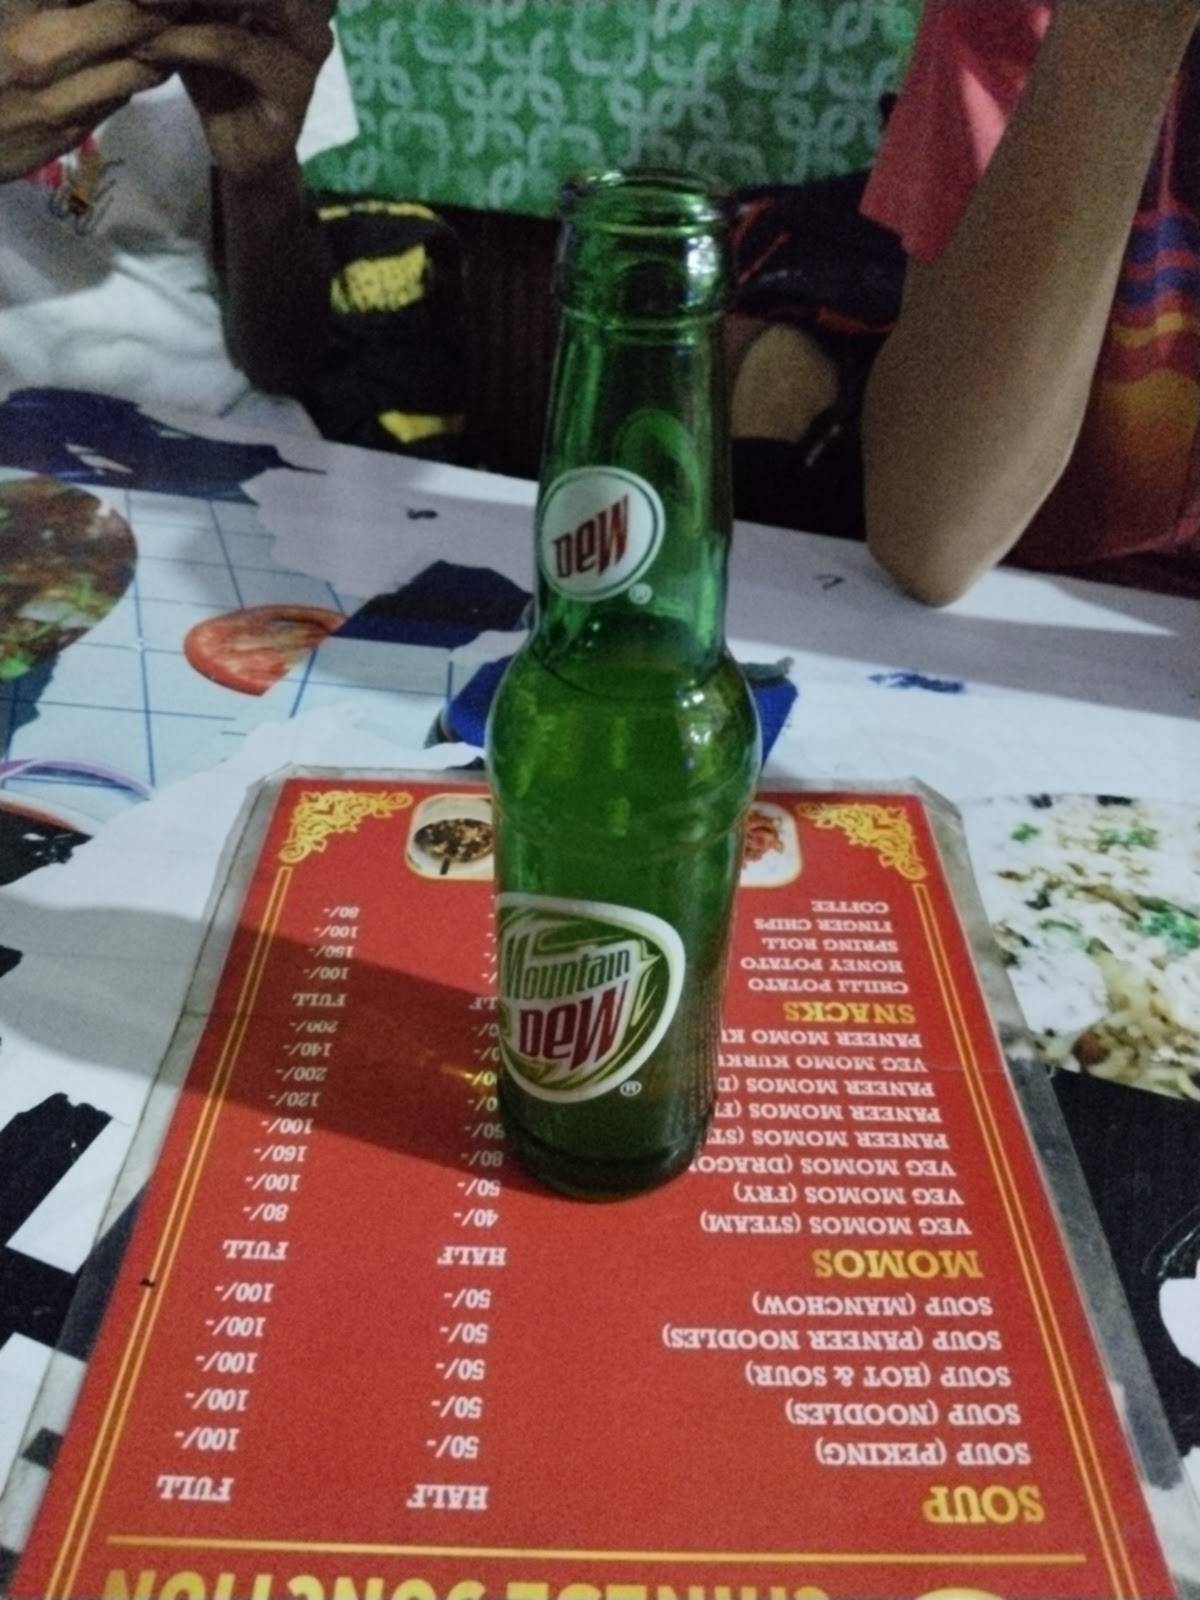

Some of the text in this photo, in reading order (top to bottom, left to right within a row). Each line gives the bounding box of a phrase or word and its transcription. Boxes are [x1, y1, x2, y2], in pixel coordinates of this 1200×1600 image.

[811, 901, 888, 913] COFFEE
[314, 925, 359, 938] 100/-
[754, 918, 892, 932] FINGER CHIPS
[762, 938, 898, 952] SPRING ROLL
[303, 966, 349, 979] 100/-
[503, 934, 630, 1001] Mountain
[741, 957, 902, 972] HONEY POTATO
[748, 978, 909, 993] CHILLI POTATO
[292, 993, 346, 1006] FULL
[783, 1002, 916, 1024] SNACKS
[752, 1030, 828, 1046] MOMO
[835, 1032, 922, 1047] PANEER
[283, 1042, 332, 1057] 140/-
[796, 1055, 875, 1071] MOMO
[882, 1058, 928, 1072] VEG
[276, 1067, 328, 1081] 200/-
[465, 1070, 497, 1084] 0/-
[718, 1075, 934, 1096] PANEER MOMOS (D
[267, 1092, 320, 1107] 120/-
[467, 1096, 497, 1110] 0/-
[714, 1100, 942, 1122] PANEER MOMOS (F
[261, 1118, 313, 1134] 100/-
[707, 1126, 948, 1148] PANEER MOMOS (ST
[687, 1154, 955, 1176] VEG MOMOS (DRAGO
[245, 1173, 301, 1190] 100/-
[457, 1179, 500, 1196] 50/-
[733, 1182, 963, 1205] VEG MOMOS (FRY)
[242, 1203, 289, 1221] 80/-
[453, 1209, 498, 1226] 40/-
[701, 1211, 971, 1234] VEG MOMOS (STEAM)
[223, 1240, 289, 1260] FULL
[437, 1246, 506, 1266] HALF
[812, 1250, 982, 1278] MOMOS
[215, 1282, 274, 1302] 100/-
[444, 1288, 491, 1308] 50/-
[753, 1291, 992, 1315] SOUP (MANCHOW)
[206, 1316, 266, 1336] 100/-
[440, 1322, 488, 1343] 50/-
[662, 1324, 1001, 1349] SOUP (PANEER NOODLES)
[196, 1351, 257, 1373] 100/-
[436, 1358, 485, 1380] 50/-
[745, 1361, 1010, 1386] SOUP (HOT & SOUR)
[185, 1389, 249, 1411] 100/-
[431, 1395, 482, 1417] 50/-
[786, 1398, 1020, 1424] SOUP (NOODLES)
[175, 1428, 239, 1450] 100/-
[427, 1435, 479, 1458] 50/-
[815, 1437, 1030, 1465] SOUP (PEKING)
[157, 1475, 234, 1501] FULL
[406, 1485, 489, 1509] HALF
[922, 1484, 1044, 1524] SOUP
